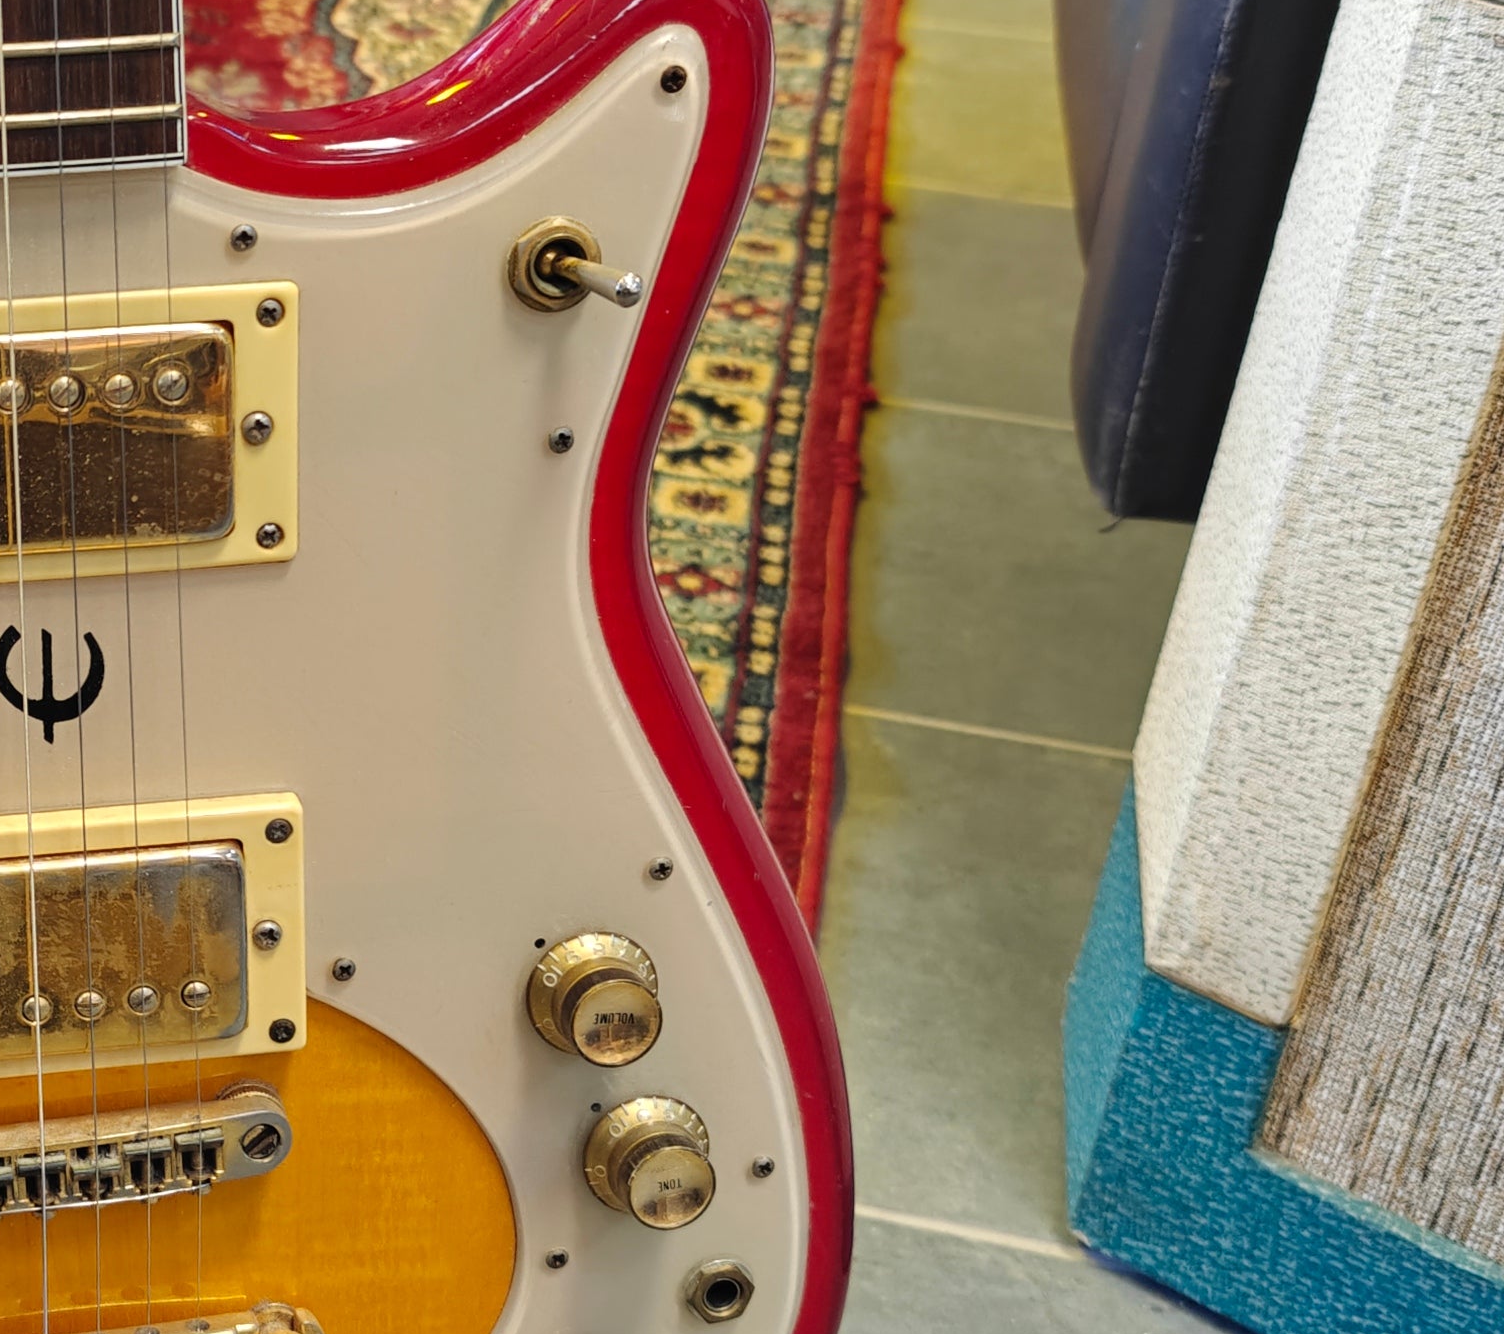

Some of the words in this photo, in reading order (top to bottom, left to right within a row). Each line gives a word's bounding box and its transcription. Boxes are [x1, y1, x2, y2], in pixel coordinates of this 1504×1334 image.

[543, 965, 563, 987] 10
[594, 1013, 635, 1024] VOLUME
[609, 1117, 629, 1137] 10
[658, 1178, 682, 1192] TONE
